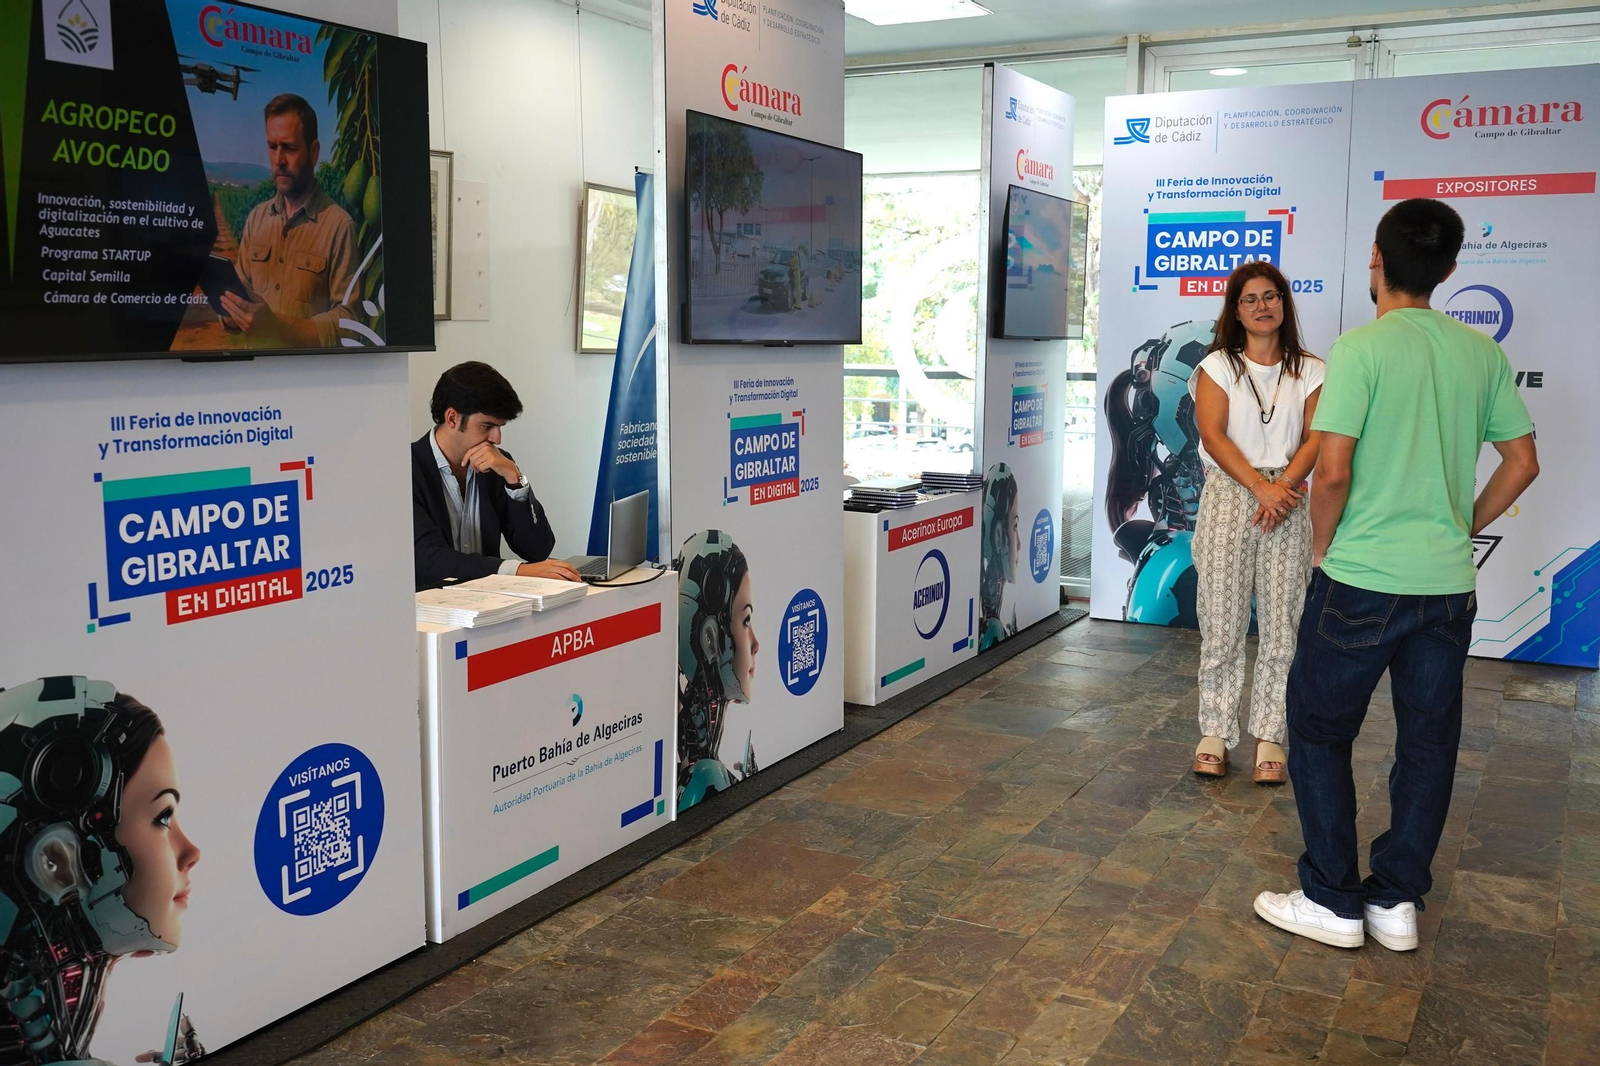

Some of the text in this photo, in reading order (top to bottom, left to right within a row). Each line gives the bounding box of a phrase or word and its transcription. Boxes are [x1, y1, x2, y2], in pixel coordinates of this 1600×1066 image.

[721, 0, 757, 15] iputación
[763, 5, 794, 24] PLANIFICACIÓN,
[721, 10, 751, 32] de Cádiz
[767, 19, 793, 35] DESARROLLO
[241, 45, 300, 63] Campo de Gibraltar
[40, 99, 177, 138] AGROPECO
[750, 108, 793, 126] Campo de Gibraltar
[1224, 106, 1342, 119] PLANIFICACIÓN, COORDINACIÓN
[1155, 115, 1212, 129] Diputación
[1231, 121, 1279, 129] DESARROLLO
[1282, 117, 1333, 126] ESTRATÉGICO
[1155, 131, 1201, 143] de Cádiz
[1474, 127, 1562, 139] Campo de Gibraltar
[52, 138, 171, 172] AVOCADO
[1156, 174, 1273, 187] III Feria de Innovación
[1436, 179, 1537, 194] EXPOSITORES
[1148, 187, 1281, 202] y Transformación Digital
[37, 192, 195, 217] Innovación, sostenibilidad y
[38, 208, 204, 229] digitalización en el cultivo de
[39, 224, 100, 239] Aguacates
[1155, 229, 1273, 249] CAMPO DE
[40, 246, 152, 262] Programa STARTUP
[1460, 240, 1548, 251] ahía de Algeciras
[42, 269, 131, 284] Capital Semilla
[1187, 280, 1208, 293] EN
[1292, 279, 1323, 293] 025
[43, 291, 208, 305] Cámara de Comercio de Cádiz
[740, 379, 754, 389] Feria
[755, 379, 763, 387] de
[764, 377, 794, 387] Innovación
[729, 389, 798, 405] y Transformación Digital
[1013, 398, 1043, 414] CAMPO DE
[110, 405, 282, 431] III Feria de Innovación
[1013, 415, 1043, 430] GIBRALTAR
[98, 425, 293, 460] y Transformación Digital
[617, 433, 655, 450] sociedad
[735, 431, 796, 455] CAMPO DE
[615, 447, 657, 465] sostenible
[735, 455, 796, 480] GIBRALTAR
[754, 477, 819, 500] EN DIGITAL 2025
[118, 494, 289, 544] CAMPO DE
[902, 513, 963, 542] Acerinox Europa
[120, 534, 291, 587] GIBRALTAR
[177, 564, 354, 617] EN DIGITAL 2025
[913, 580, 944, 610] ACERINOX
[791, 599, 816, 613] VISÍTANOS
[550, 626, 595, 658] APBA
[492, 712, 643, 782] Puerto Bahía de Algeciras
[288, 757, 351, 787] VISÍTANOS
[493, 744, 643, 815] Autoridad Portuaria de la Bahía de Algeciras
